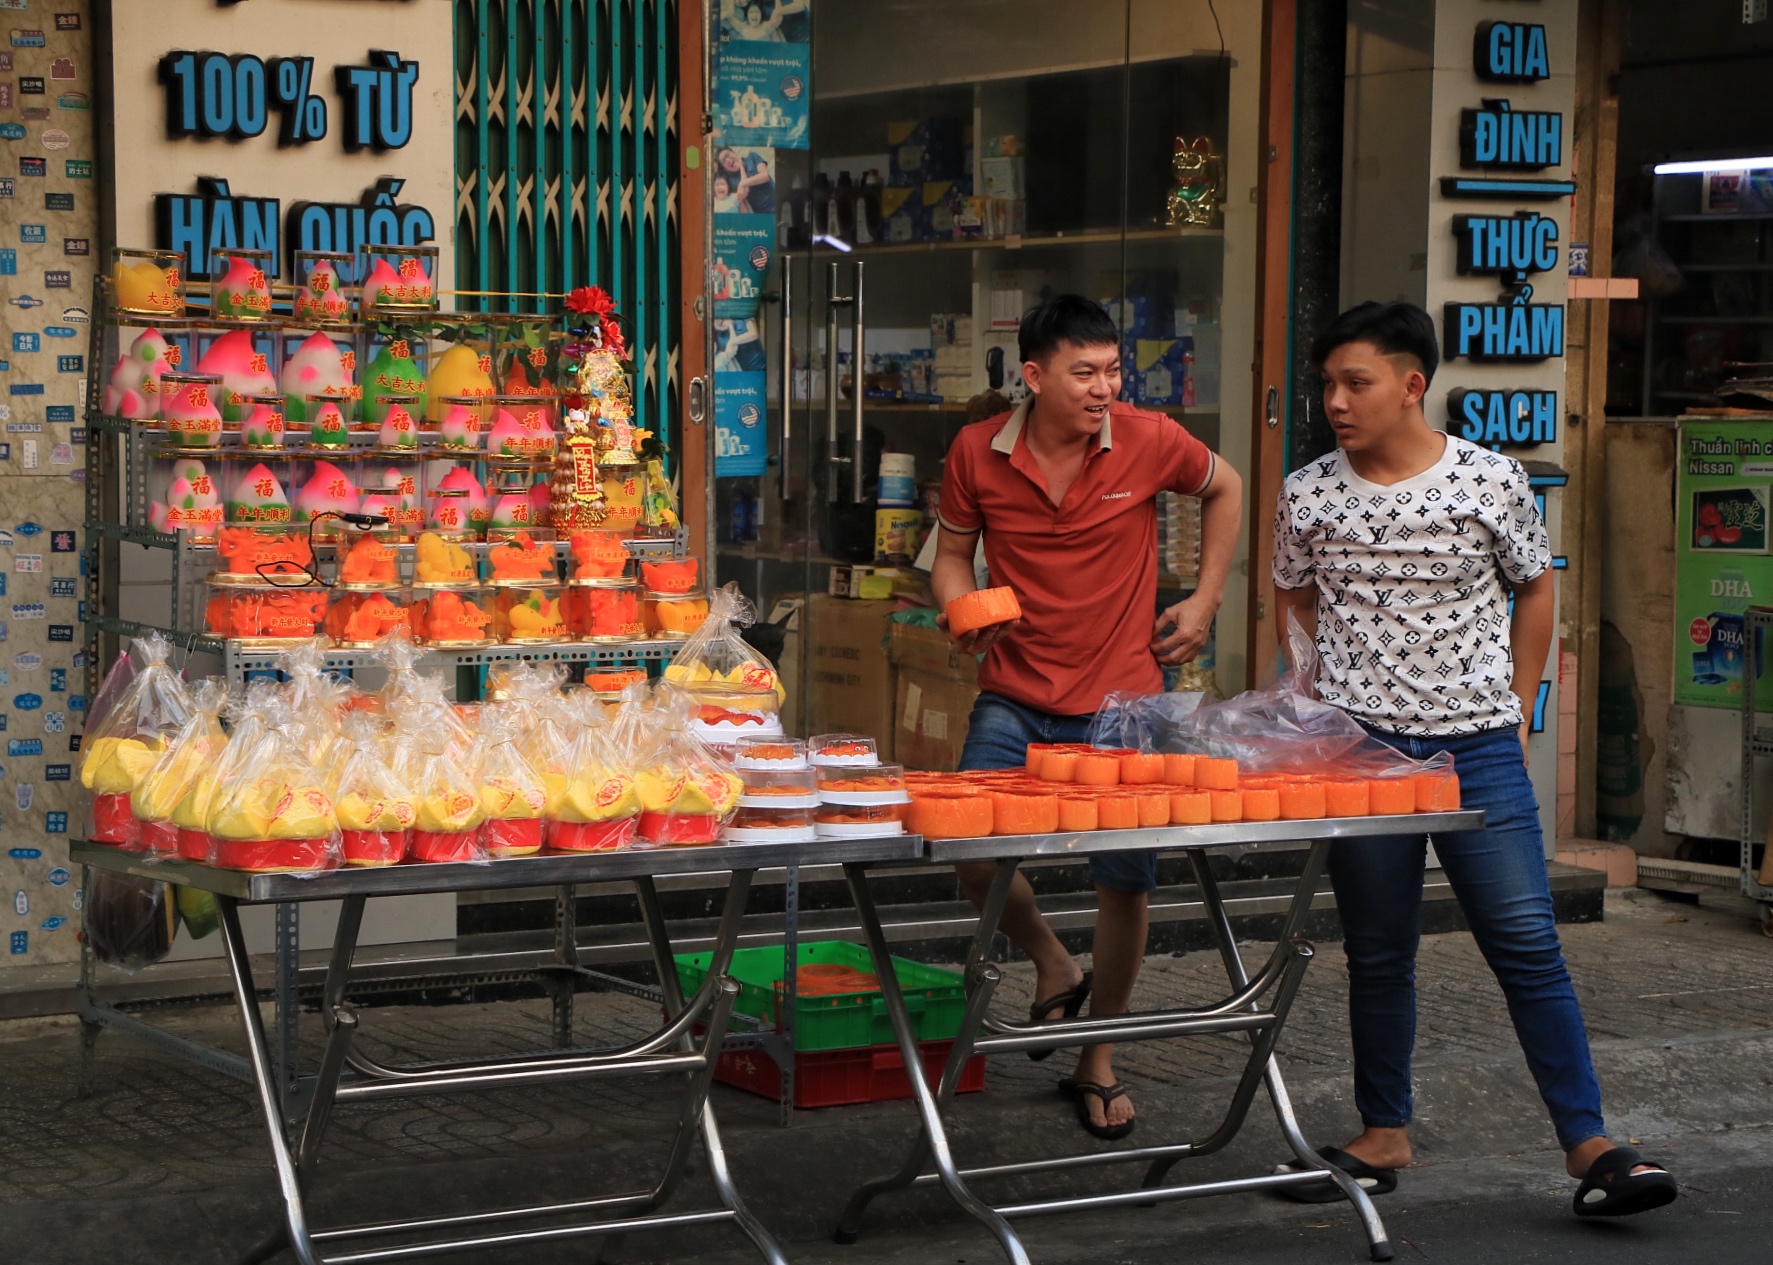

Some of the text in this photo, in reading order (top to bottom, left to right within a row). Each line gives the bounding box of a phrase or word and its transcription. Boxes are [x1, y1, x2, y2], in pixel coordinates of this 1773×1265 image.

[1488, 23, 1549, 80] GIA
[170, 52, 419, 149] 100% TỪ
[1474, 101, 1562, 167] ĐÌNH
[168, 180, 281, 280] HÀN
[1466, 213, 1559, 281] THỰC
[399, 259, 417, 278] 福
[166, 270, 179, 288] 福
[248, 270, 265, 289] 福
[312, 273, 330, 291] 福
[381, 285, 432, 298] 大吉大利
[297, 297, 348, 313] 年年順利
[1459, 285, 1564, 358] PHẨM
[163, 345, 181, 364] 福
[390, 340, 409, 359] 福
[527, 347, 547, 366] 福
[250, 354, 267, 373] 福
[340, 351, 355, 370] 福
[477, 355, 491, 374] 福
[376, 374, 426, 393] 大吉大利
[189, 388, 207, 407] 福
[169, 419, 221, 433] 金玉滿堂
[266, 413, 283, 433] 福
[321, 413, 341, 433] 福
[392, 412, 410, 431] 福
[465, 414, 480, 432] 福
[524, 412, 541, 431] 福
[1461, 390, 1556, 452] SẠCH
[504, 437, 554, 450] 年年順利
[1689, 460, 1734, 474] Nissan
[191, 476, 210, 495] 福
[254, 479, 274, 498] 福
[328, 480, 346, 498] 福
[397, 477, 415, 495] 福
[623, 479, 635, 496] 福
[168, 508, 223, 522] 金玉滿堂
[237, 506, 290, 520] 年年順利
[440, 507, 458, 526] 福
[512, 504, 528, 522] 福
[1710, 579, 1753, 598] DHA
[1717, 629, 1744, 645] DHA
